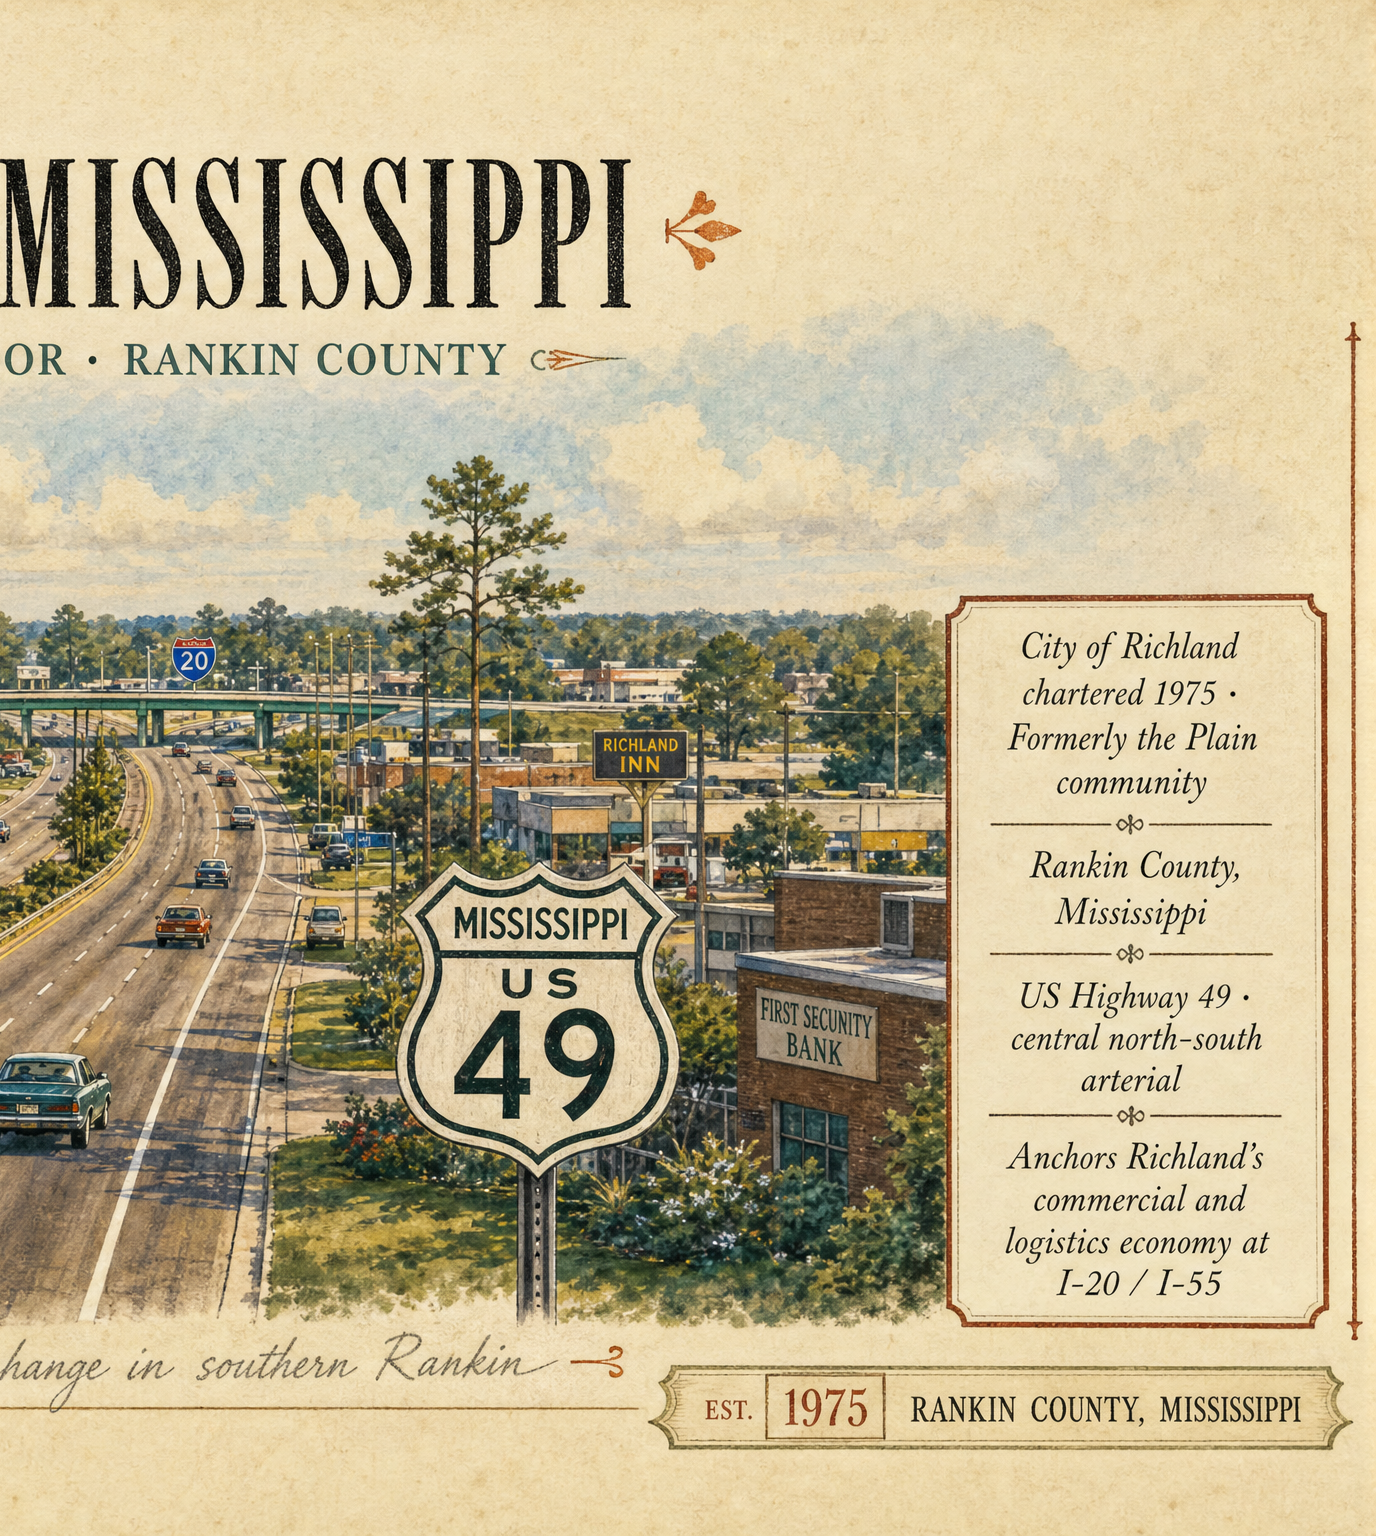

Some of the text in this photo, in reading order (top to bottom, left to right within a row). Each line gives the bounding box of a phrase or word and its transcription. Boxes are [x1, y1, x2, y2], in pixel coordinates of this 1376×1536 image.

[181, 651, 208, 670] 20
[604, 738, 678, 752] RICHLAND
[621, 756, 659, 772] INN
[454, 907, 627, 940] MISSISSIPPI
[502, 968, 577, 999] US
[761, 997, 799, 1026] FIRST
[786, 1031, 842, 1067] BANK
[454, 1009, 615, 1122] 49
